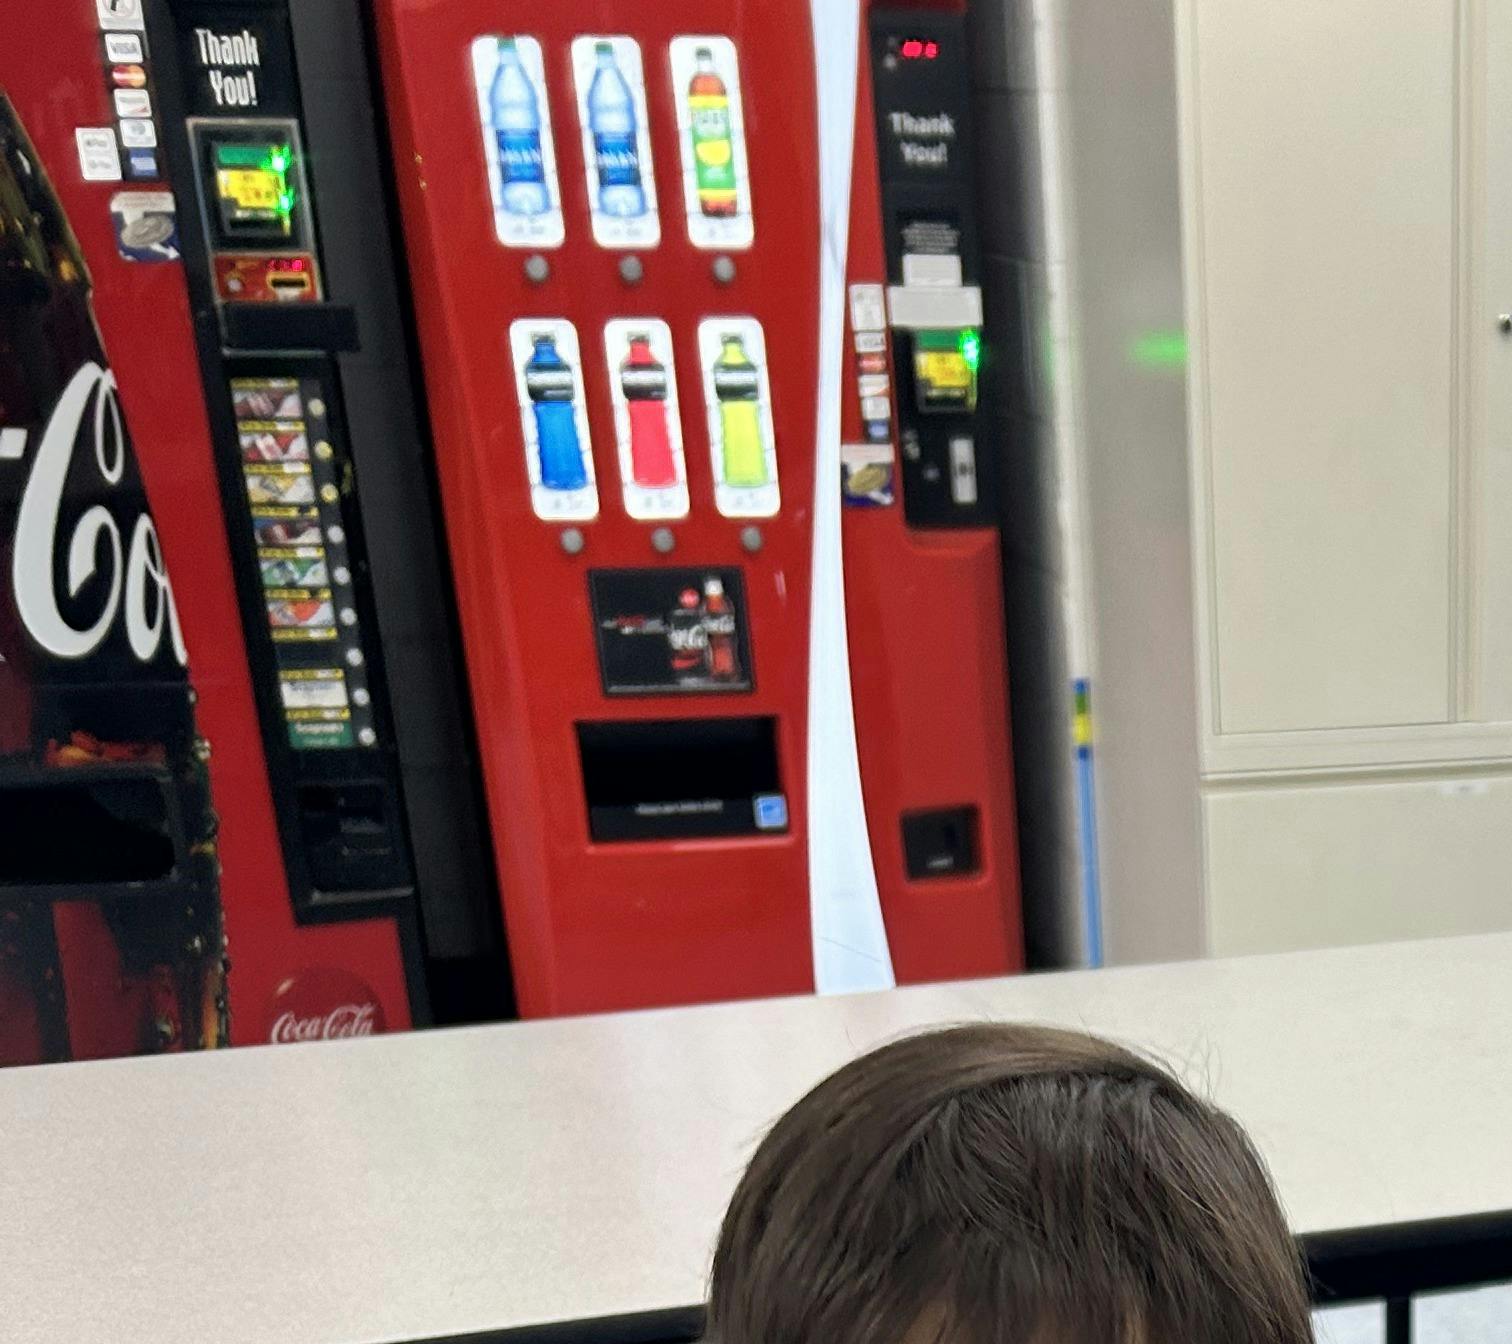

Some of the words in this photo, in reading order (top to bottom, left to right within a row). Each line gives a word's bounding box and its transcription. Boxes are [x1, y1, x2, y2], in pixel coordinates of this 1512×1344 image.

[196, 28, 260, 66] Thank
[209, 70, 258, 106] You!
[888, 112, 956, 136] Thank
